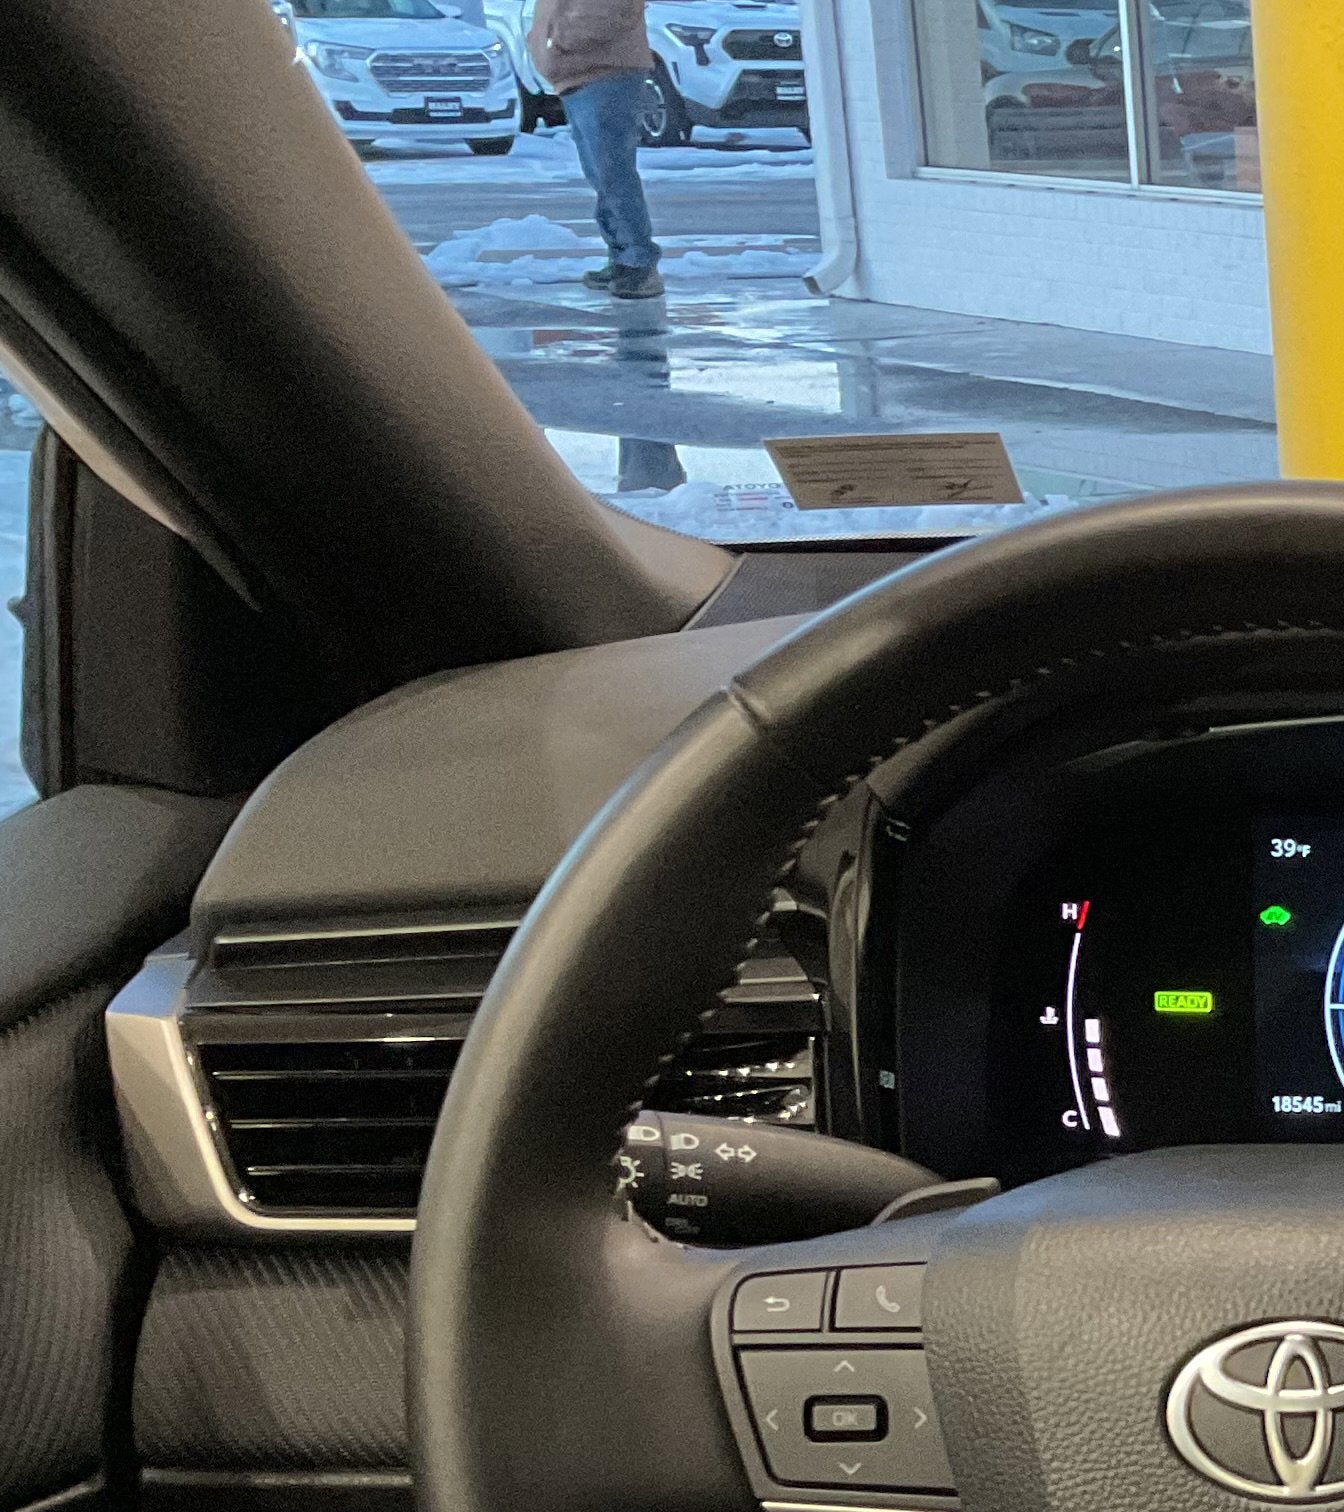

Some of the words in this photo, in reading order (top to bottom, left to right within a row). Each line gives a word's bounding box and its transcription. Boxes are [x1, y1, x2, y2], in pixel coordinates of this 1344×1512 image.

[1062, 903, 1077, 920] H
[1158, 995, 1208, 1009] READY
[1062, 1110, 1077, 1127] C
[666, 1193, 708, 1207] AUTO
[832, 1409, 859, 1427] OK
